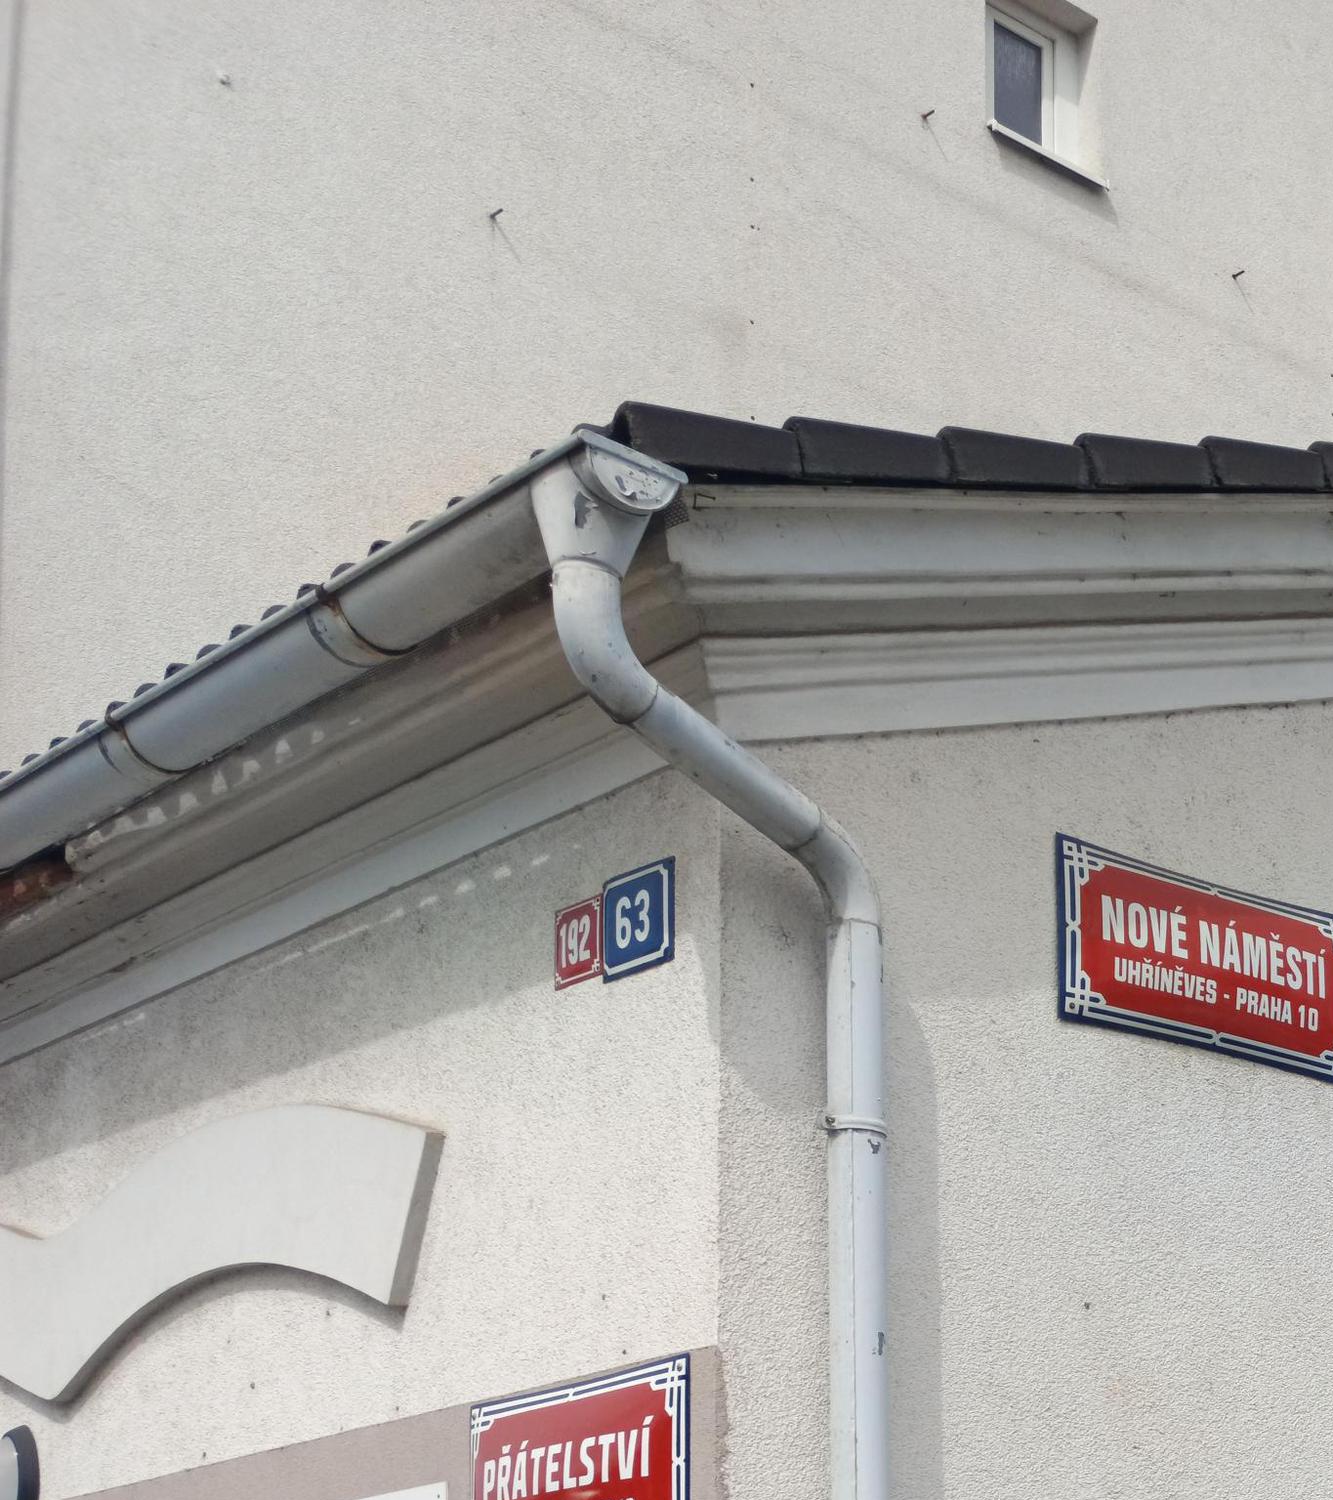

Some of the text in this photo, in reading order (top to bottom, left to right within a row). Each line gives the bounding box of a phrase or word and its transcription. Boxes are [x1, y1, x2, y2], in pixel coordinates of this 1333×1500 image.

[560, 914, 591, 968] 192
[615, 889, 651, 949] 63
[1101, 894, 1326, 999] NOVÉ NÁMĚSTÍ
[1114, 956, 1217, 1004] UHŘÍNĚVES
[1236, 987, 1292, 1025] PRAHA
[1298, 1004, 1319, 1032] 10
